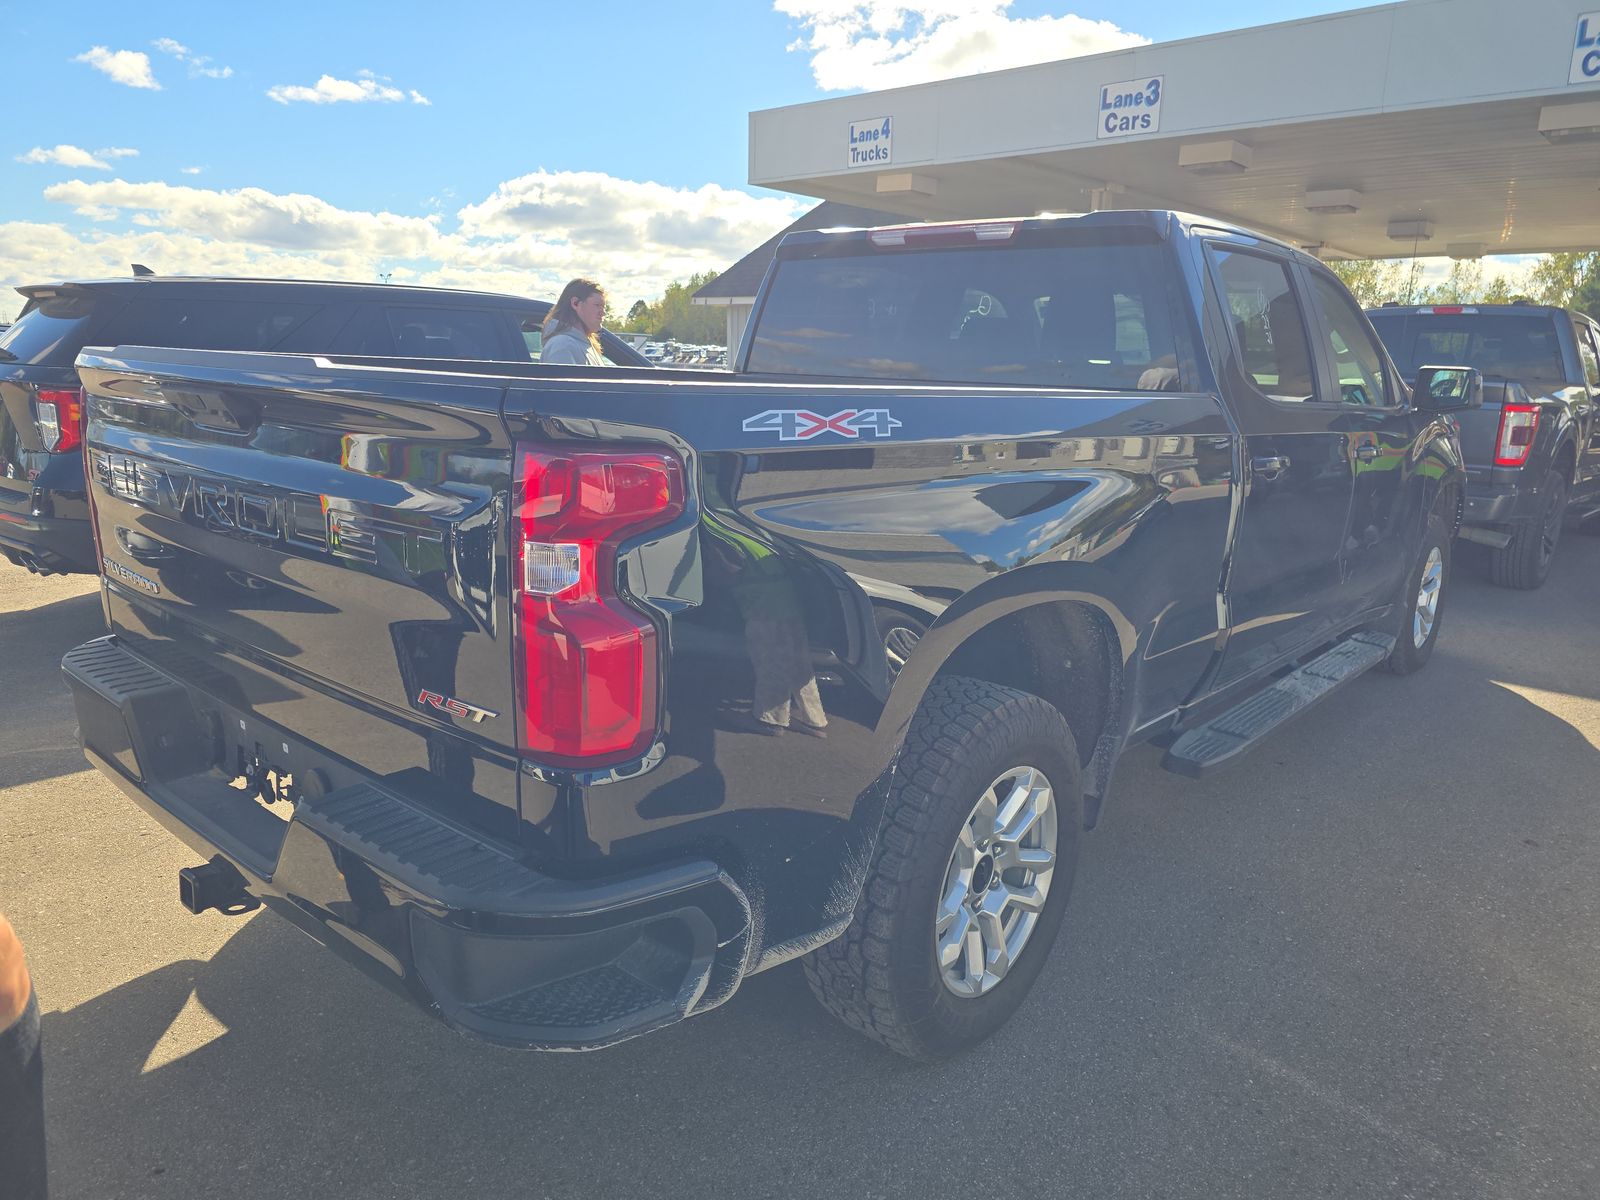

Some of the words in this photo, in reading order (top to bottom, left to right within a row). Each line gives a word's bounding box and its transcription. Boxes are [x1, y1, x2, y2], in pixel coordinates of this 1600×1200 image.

[1104, 112, 1151, 133] Cars
[850, 145, 888, 163] Trucks
[102, 557, 161, 595] SILVERADO
[417, 688, 498, 723] RST
